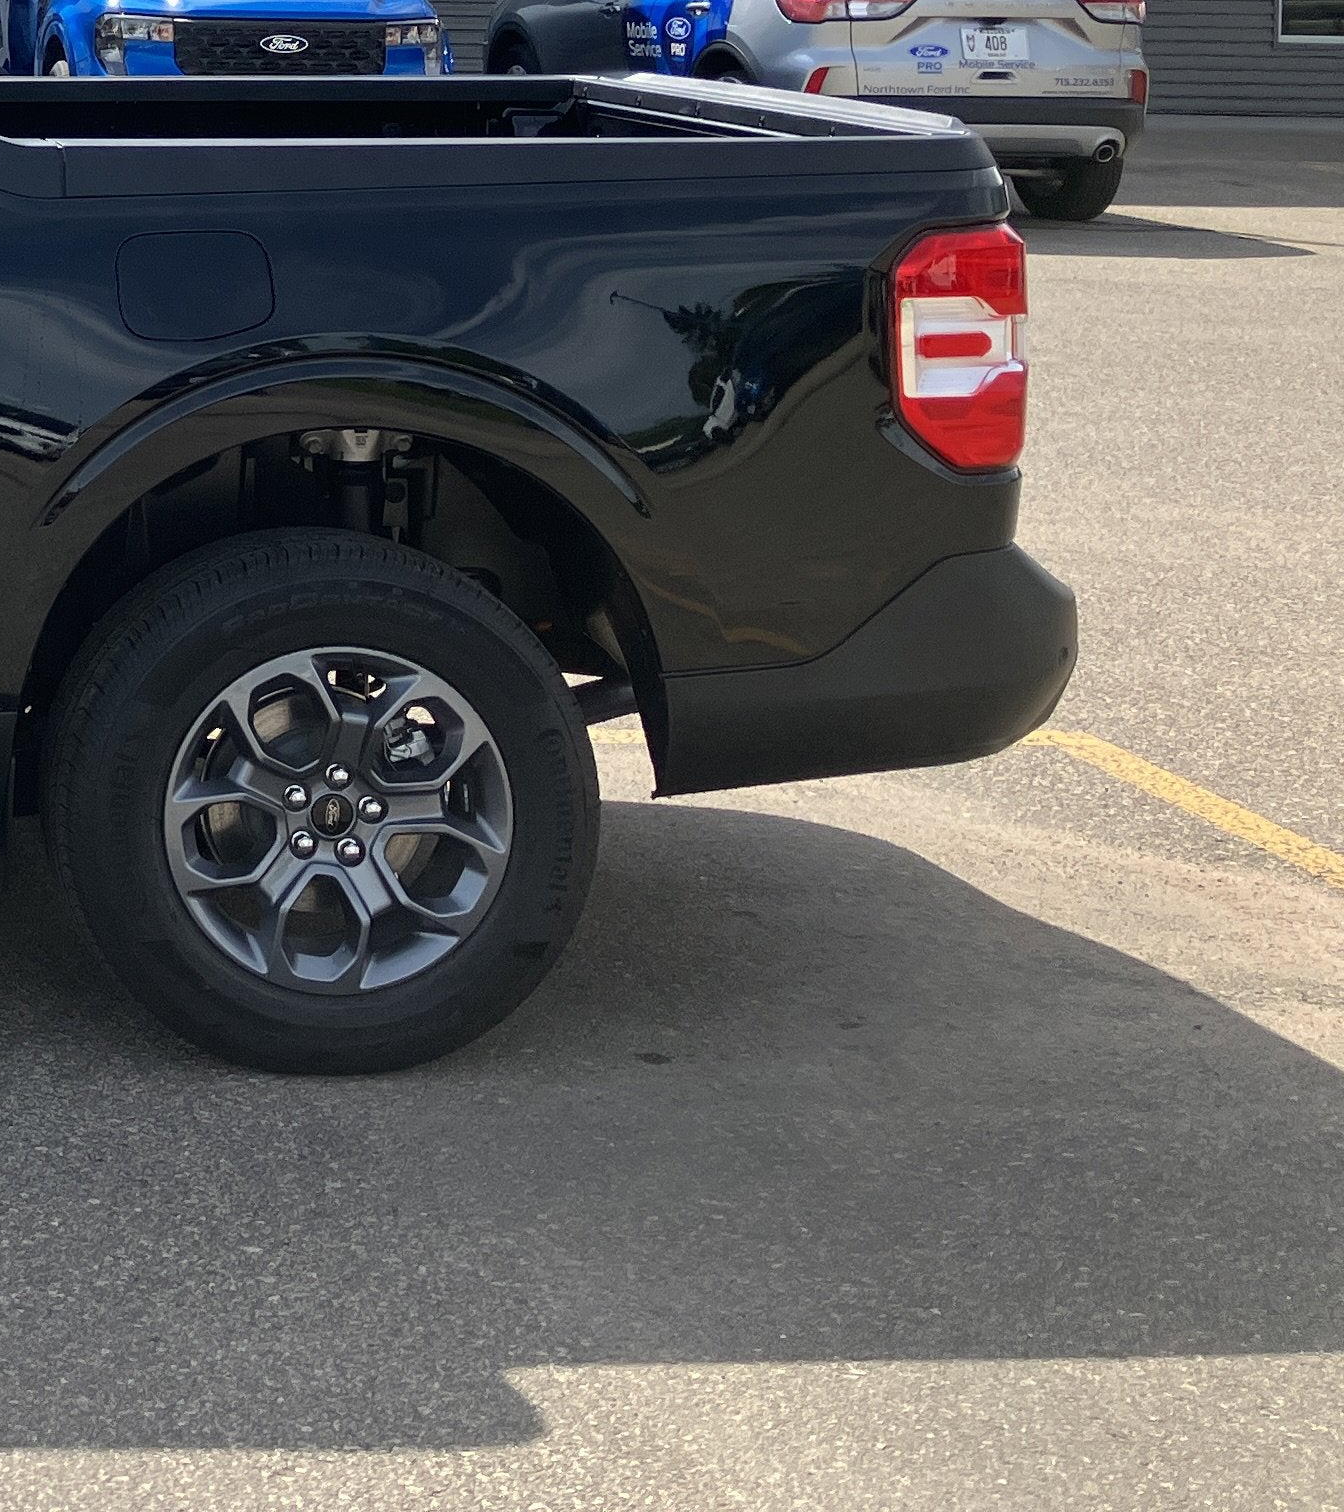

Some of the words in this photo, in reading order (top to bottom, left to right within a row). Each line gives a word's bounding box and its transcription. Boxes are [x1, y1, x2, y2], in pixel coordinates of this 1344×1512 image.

[626, 21, 658, 39] Mobile
[269, 38, 300, 50] Ford
[628, 40, 662, 58] Service
[985, 35, 1008, 51] 408
[670, 42, 686, 57] PRO
[916, 46, 942, 57] Ford
[917, 61, 943, 70] PRO
[959, 59, 995, 69] Mobile
[997, 59, 1036, 69] Service
[863, 84, 925, 94] Northtown
[927, 85, 952, 94] Ford
